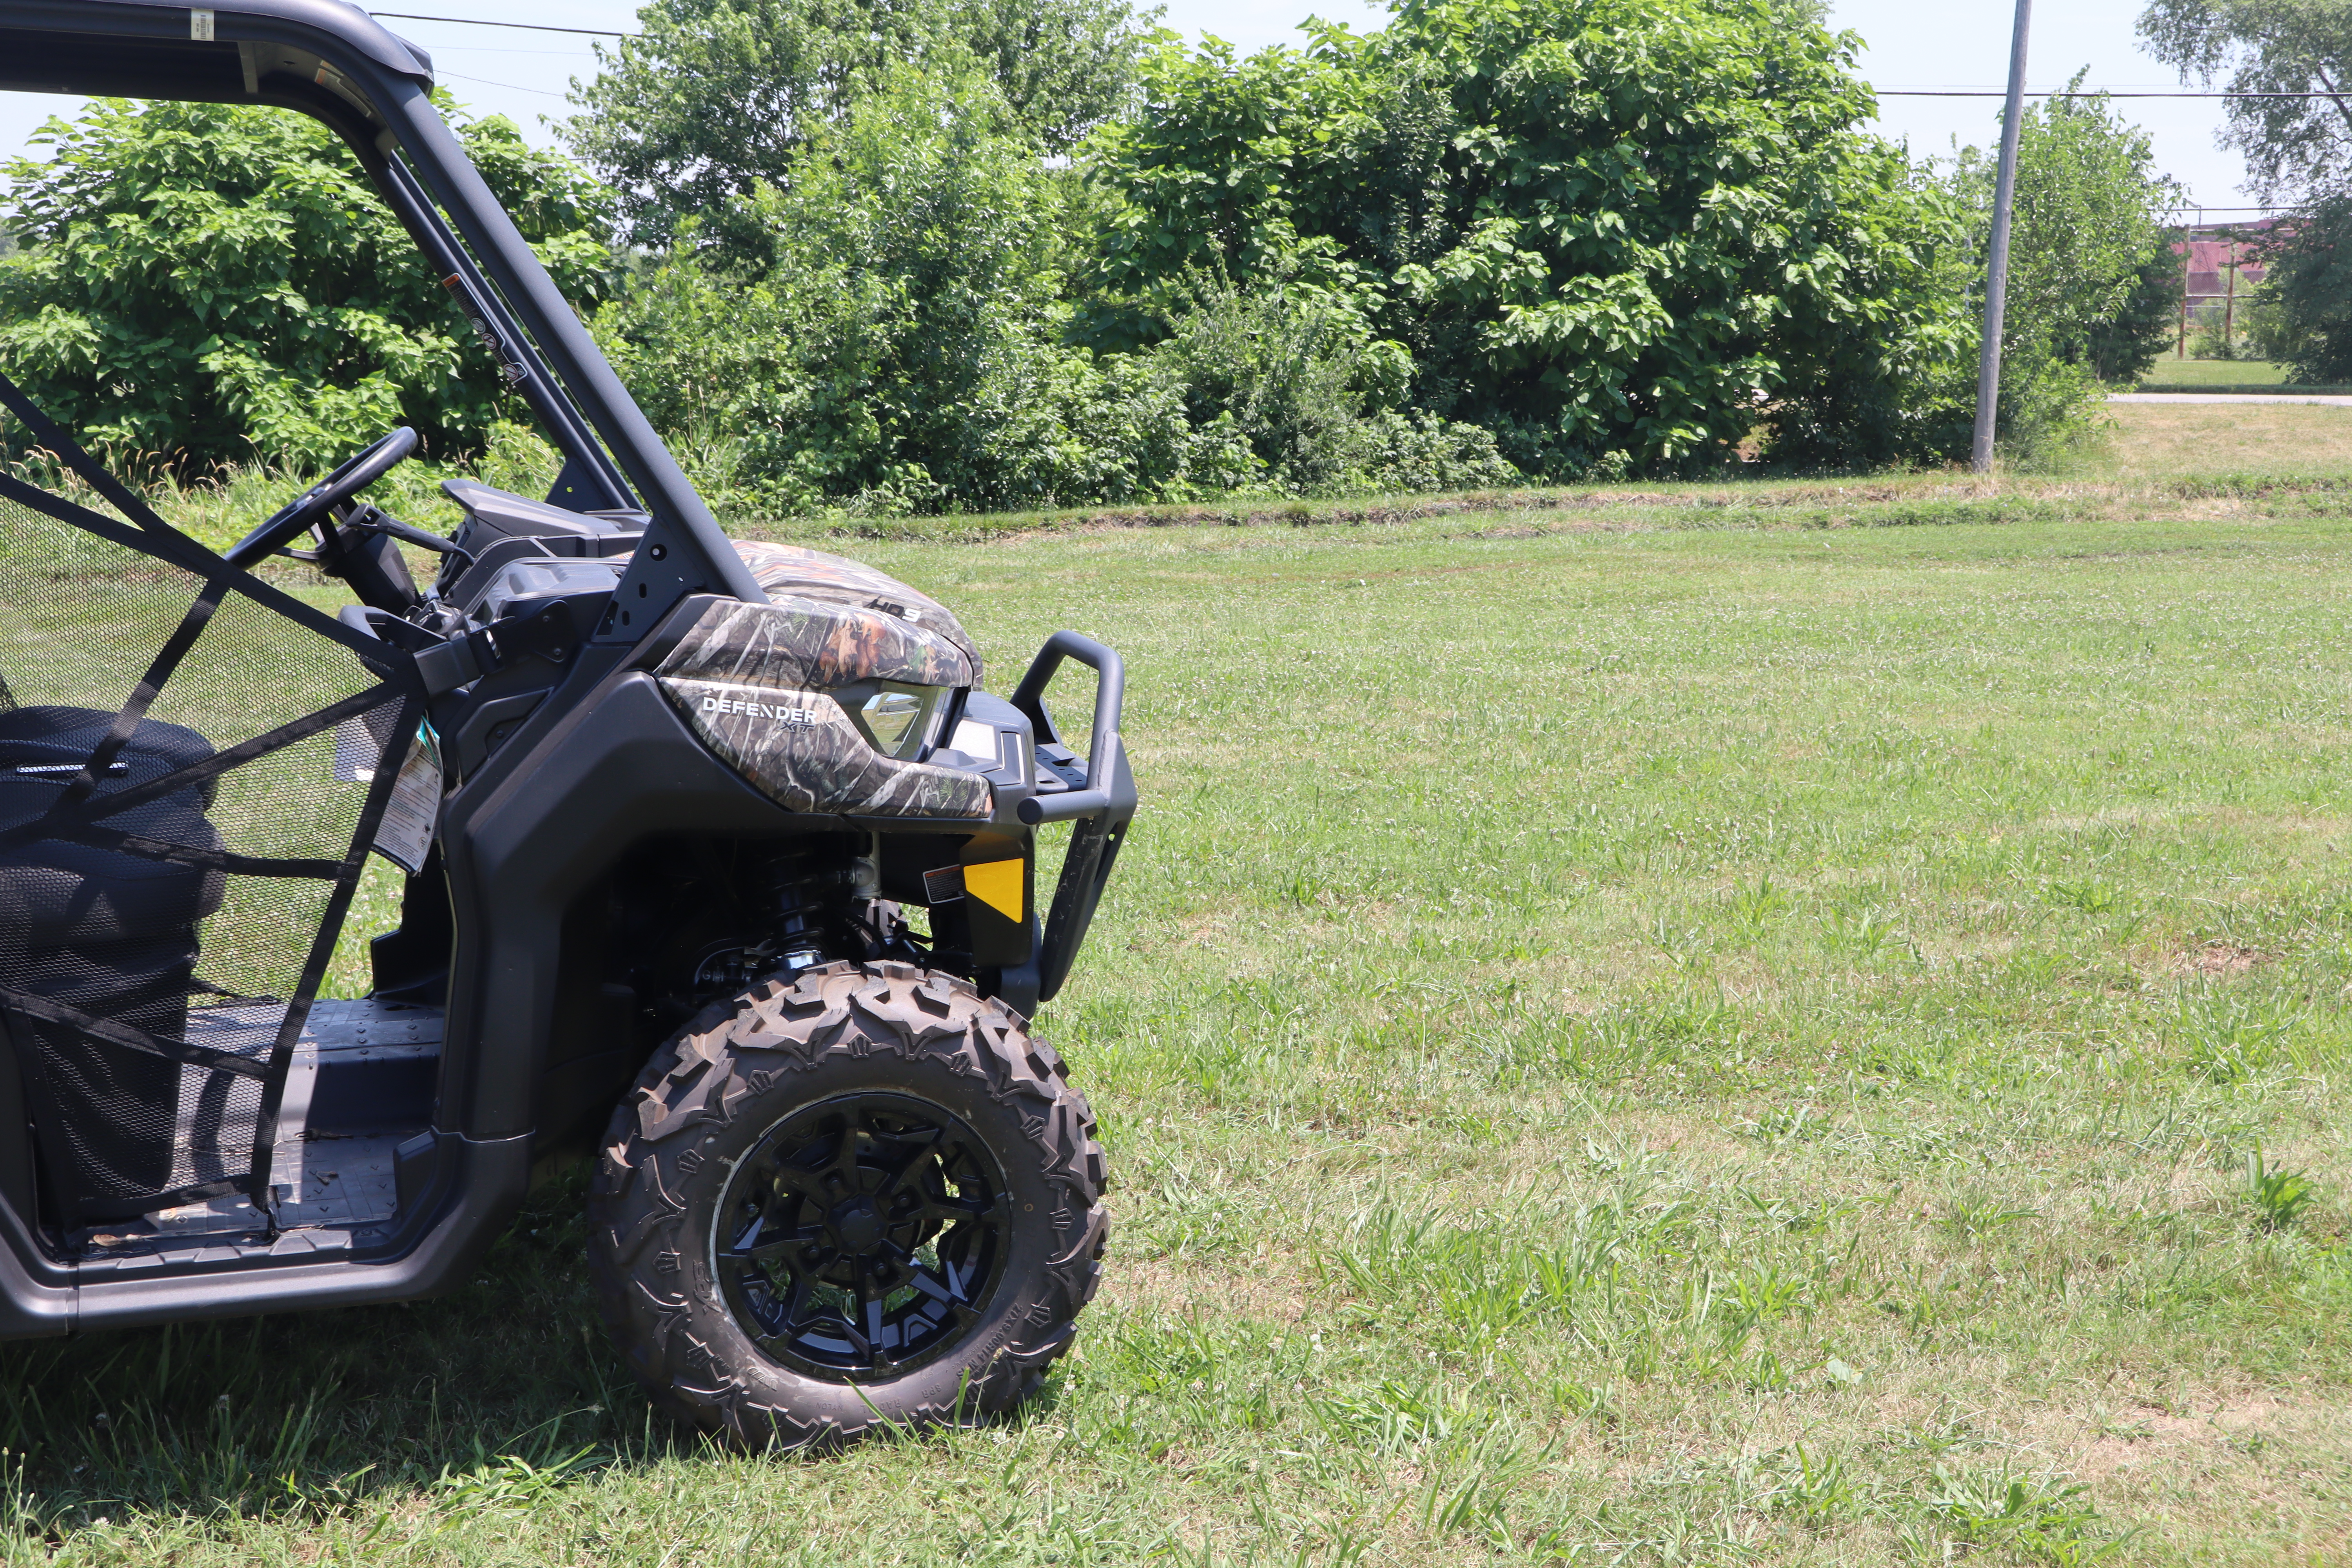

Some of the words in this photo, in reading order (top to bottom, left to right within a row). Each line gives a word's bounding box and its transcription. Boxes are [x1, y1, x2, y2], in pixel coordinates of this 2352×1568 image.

[863, 596, 922, 622] HD9
[703, 697, 817, 723] DEFENDER
[777, 721, 816, 733] XT
[922, 1383, 942, 1398] 8PR
[816, 1402, 842, 1411] NYLON
[860, 1398, 902, 1413] RADAL
